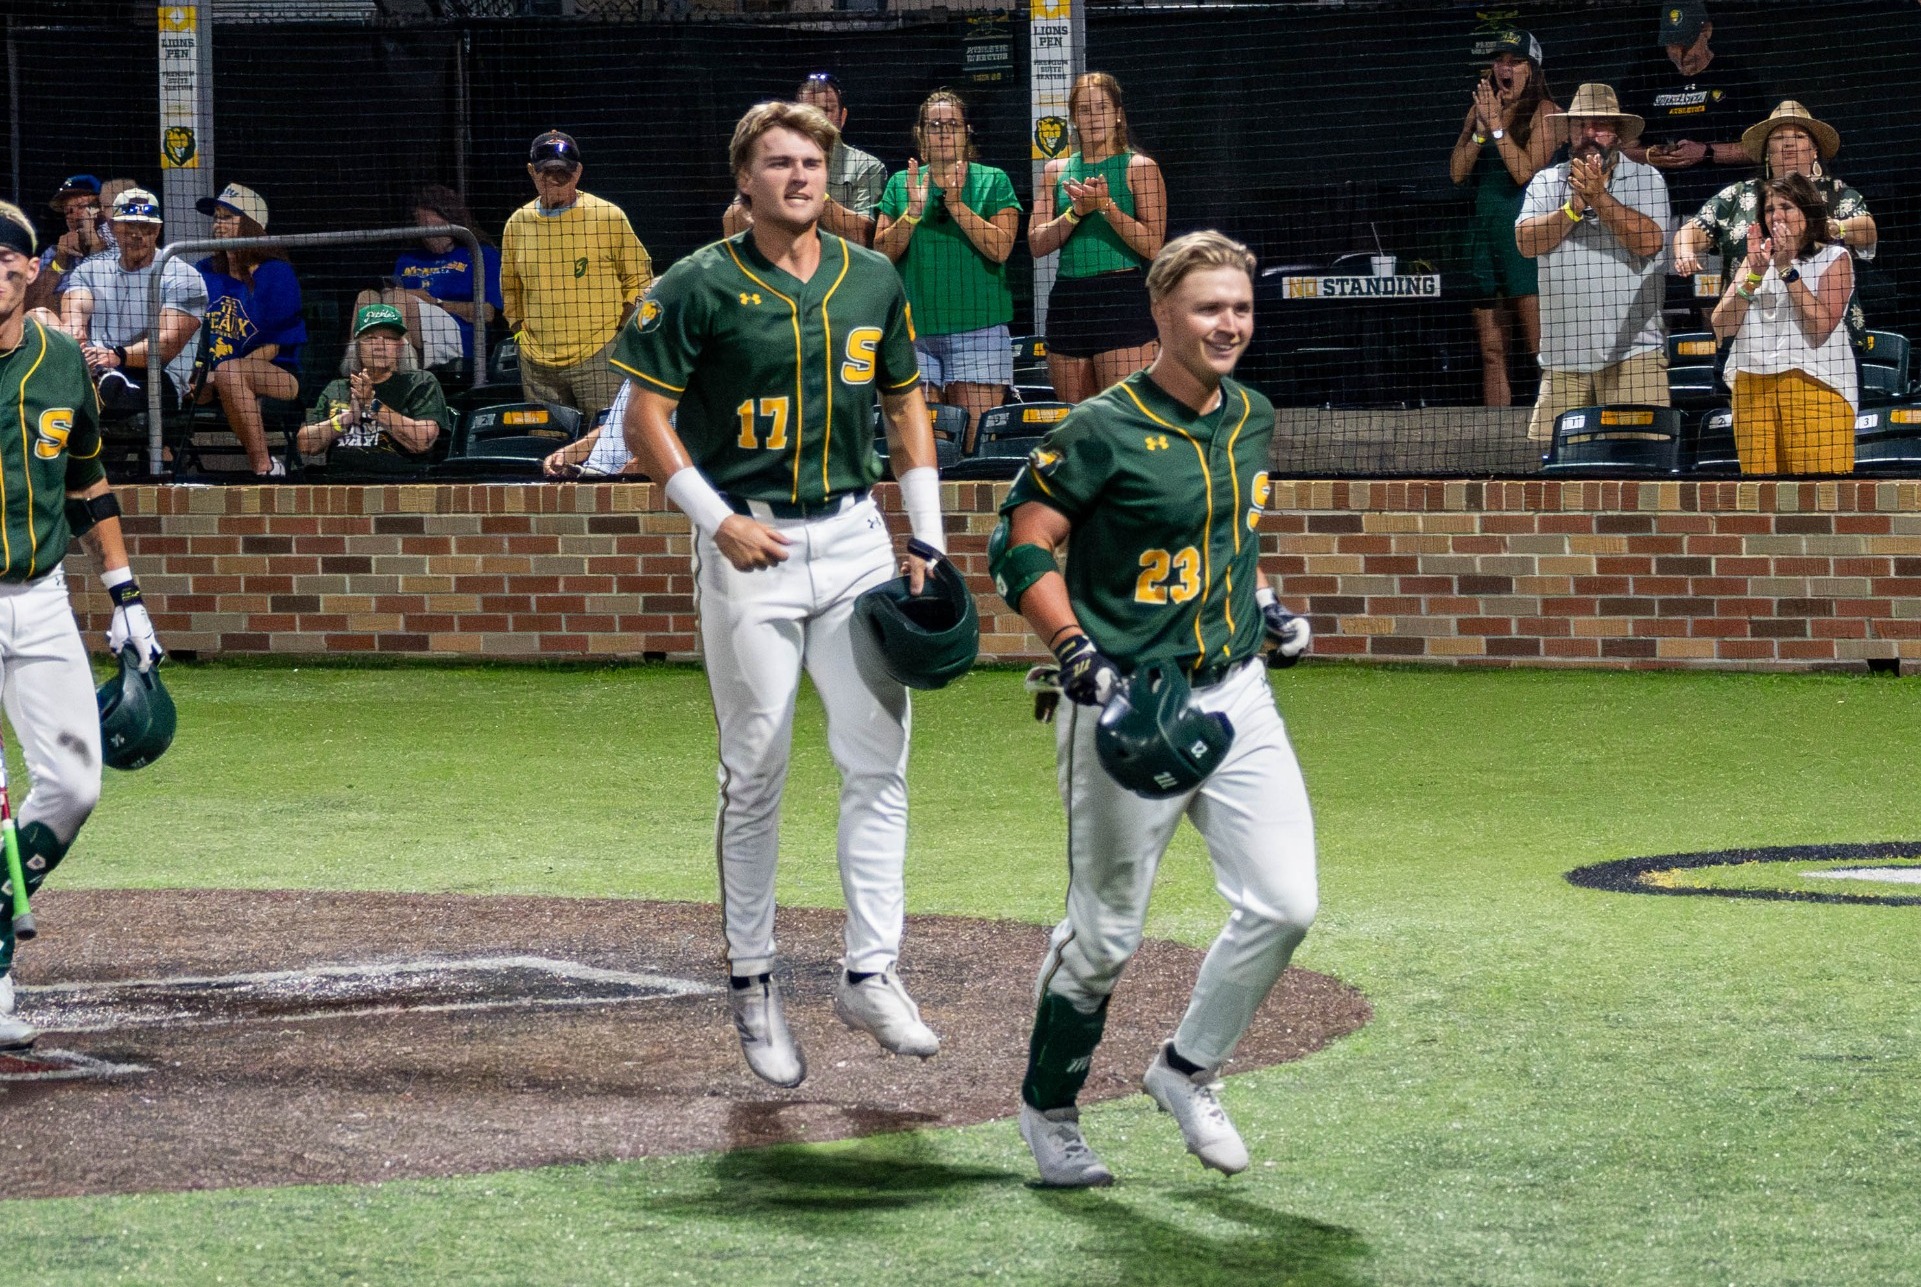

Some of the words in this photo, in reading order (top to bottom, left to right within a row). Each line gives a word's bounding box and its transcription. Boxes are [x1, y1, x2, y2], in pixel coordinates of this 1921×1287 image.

[1033, 25, 1069, 35] LIONS
[161, 38, 195, 48] LIONS
[1039, 36, 1063, 47] PEN
[167, 49, 189, 58] PEN
[1289, 277, 1317, 298] NO
[1323, 276, 1435, 297] STANDING
[841, 326, 883, 386] S
[34, 407, 75, 460] S
[737, 396, 789, 450] 17
[1134, 546, 1201, 605] 23
